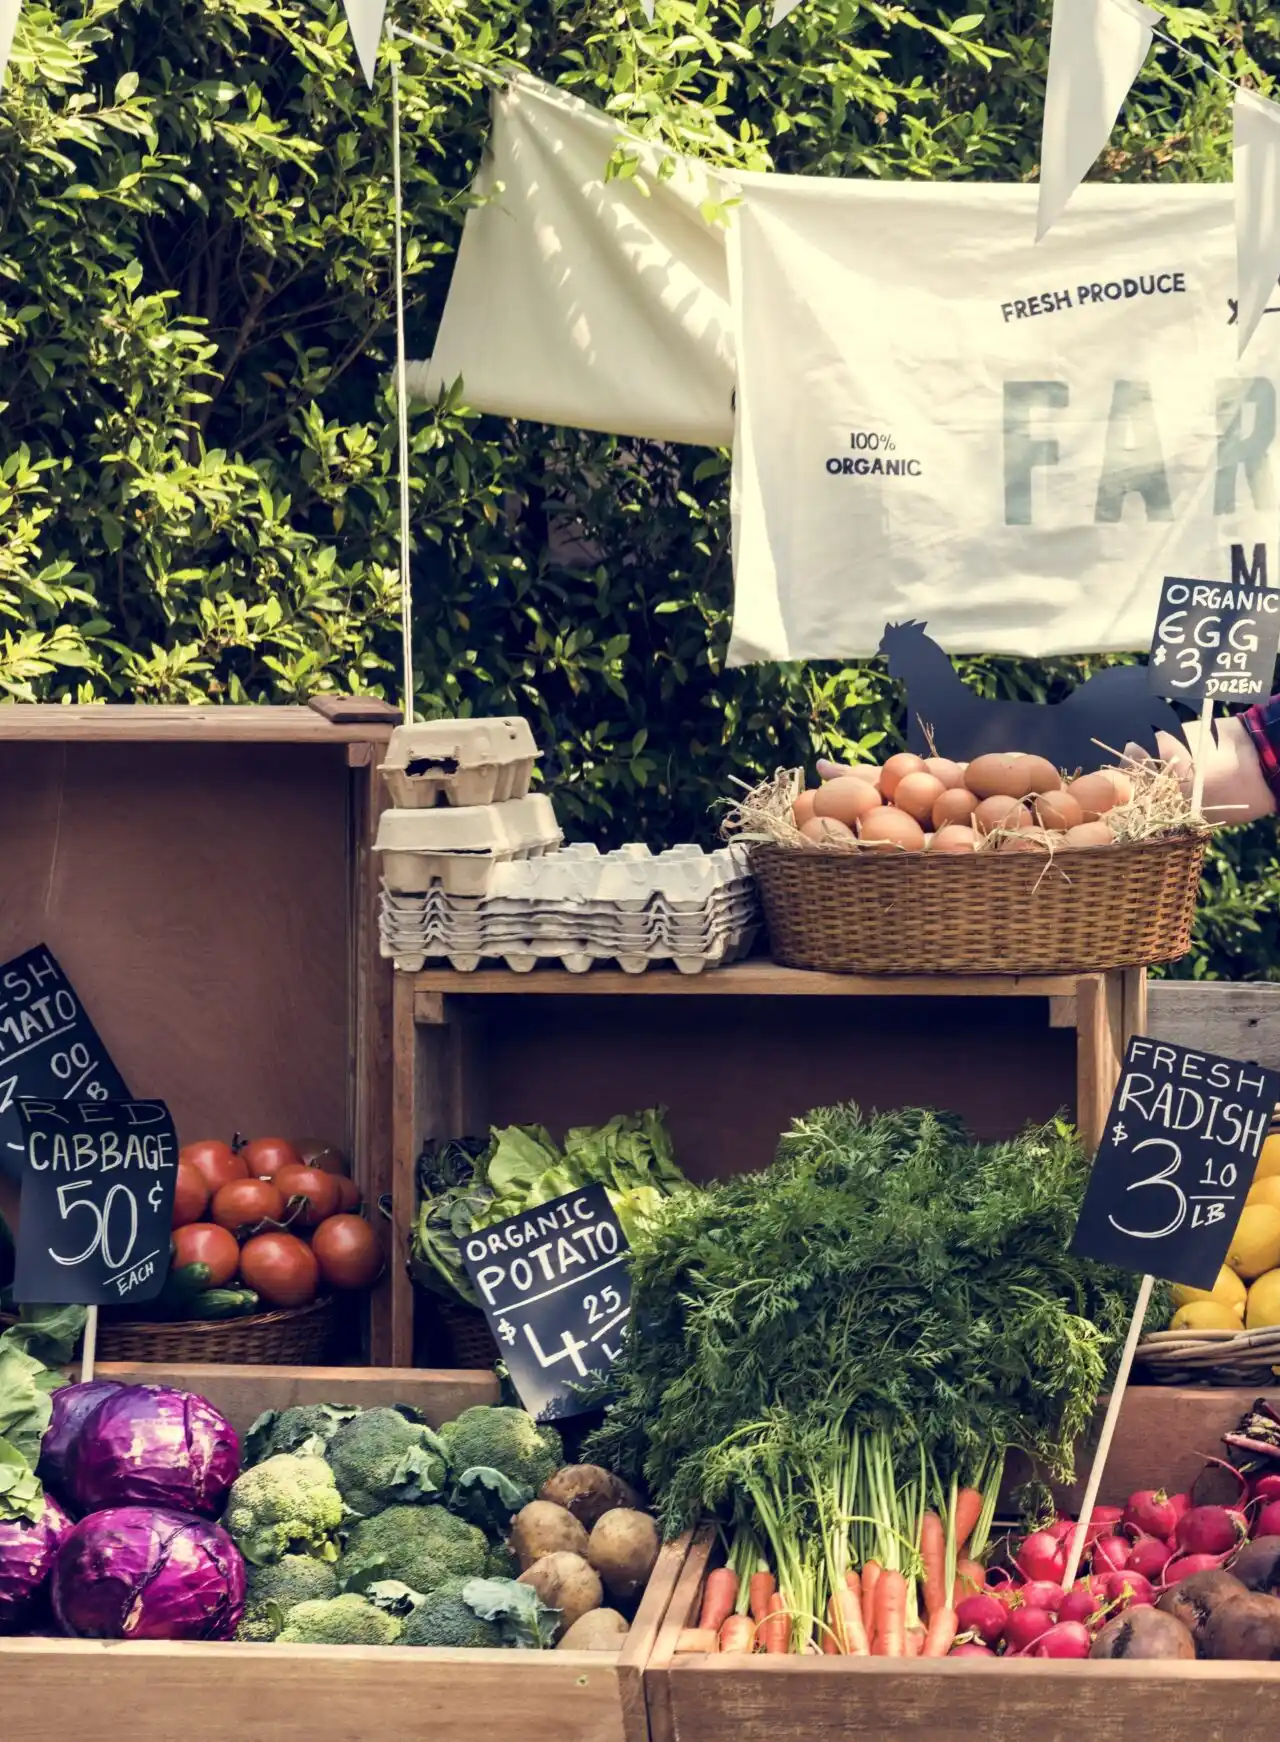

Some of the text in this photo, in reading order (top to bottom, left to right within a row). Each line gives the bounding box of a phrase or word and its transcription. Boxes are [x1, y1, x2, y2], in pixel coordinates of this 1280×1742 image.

[1001, 273, 1186, 323] FRESH PRODUCE
[850, 432, 896, 451] 100%
[826, 457, 922, 476] ORGANIC
[1166, 584, 1279, 613] ORGANIC
[1158, 610, 1259, 652] EGG
[1216, 652, 1248, 670] 99
[1205, 678, 1263, 696] DOZEN
[0, 990, 76, 1051] MATO
[1130, 1042, 1265, 1098] FRESH
[20, 1102, 166, 1125] RED
[1118, 1073, 1267, 1157] RADISH
[29, 1131, 174, 1172] CABBAGE
[1200, 1158, 1237, 1187] 10
[466, 1197, 595, 1262] ORGANIC
[1190, 1203, 1225, 1229] LB
[117, 1262, 154, 1296] EACH
[476, 1221, 618, 1305] POTATO
[583, 1285, 621, 1324] 25
